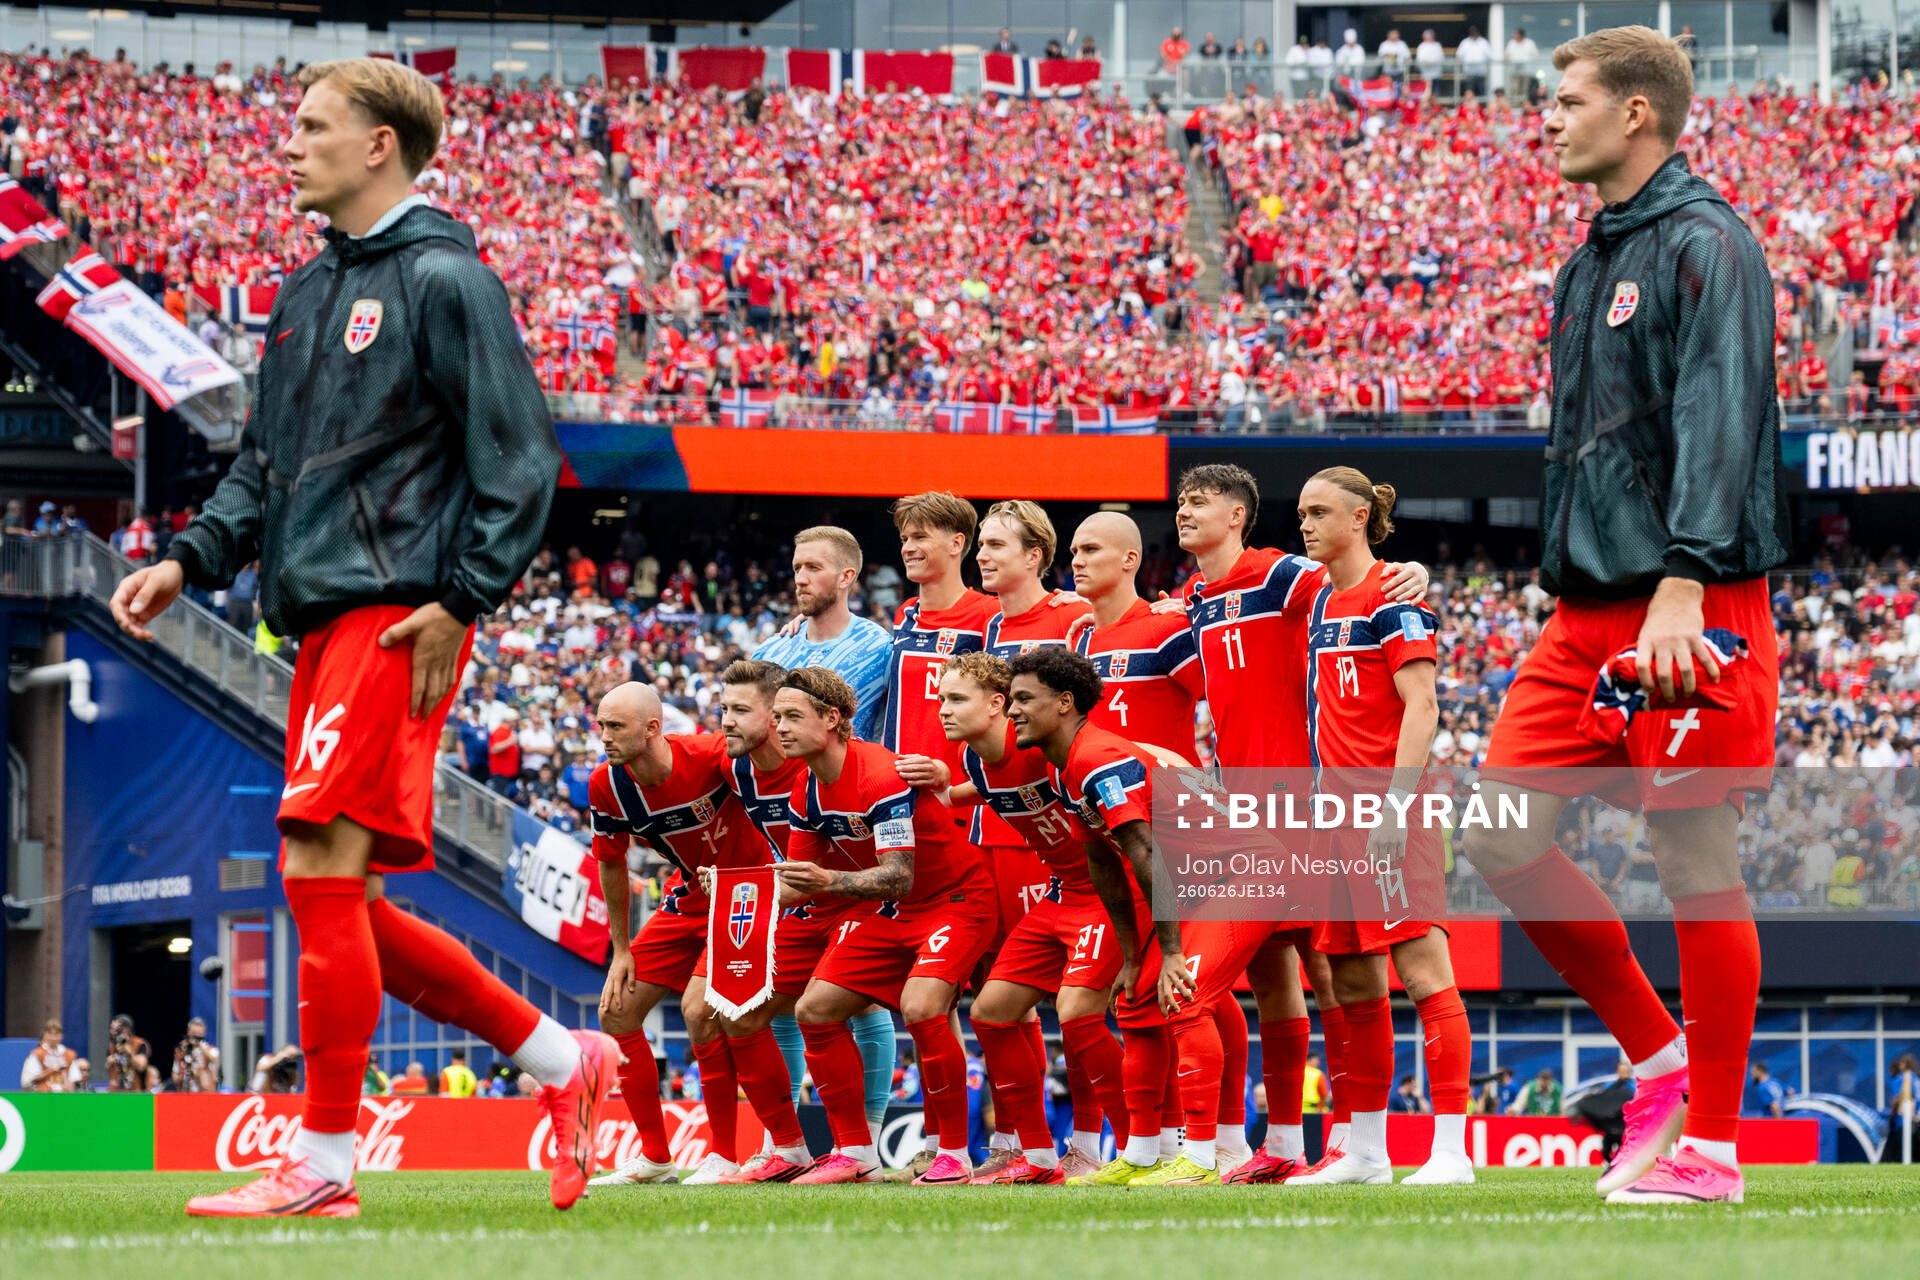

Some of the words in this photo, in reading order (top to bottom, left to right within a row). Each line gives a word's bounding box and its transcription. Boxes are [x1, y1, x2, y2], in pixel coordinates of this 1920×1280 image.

[1222, 628, 1245, 670] 11
[1336, 656, 1359, 698] 19
[1109, 688, 1129, 727] 4
[294, 703, 346, 771] 16
[701, 817, 728, 855] 14
[1032, 809, 1071, 846] 21
[1376, 868, 1409, 912] 19
[928, 925, 952, 953] 6
[1073, 924, 1105, 960] 21
